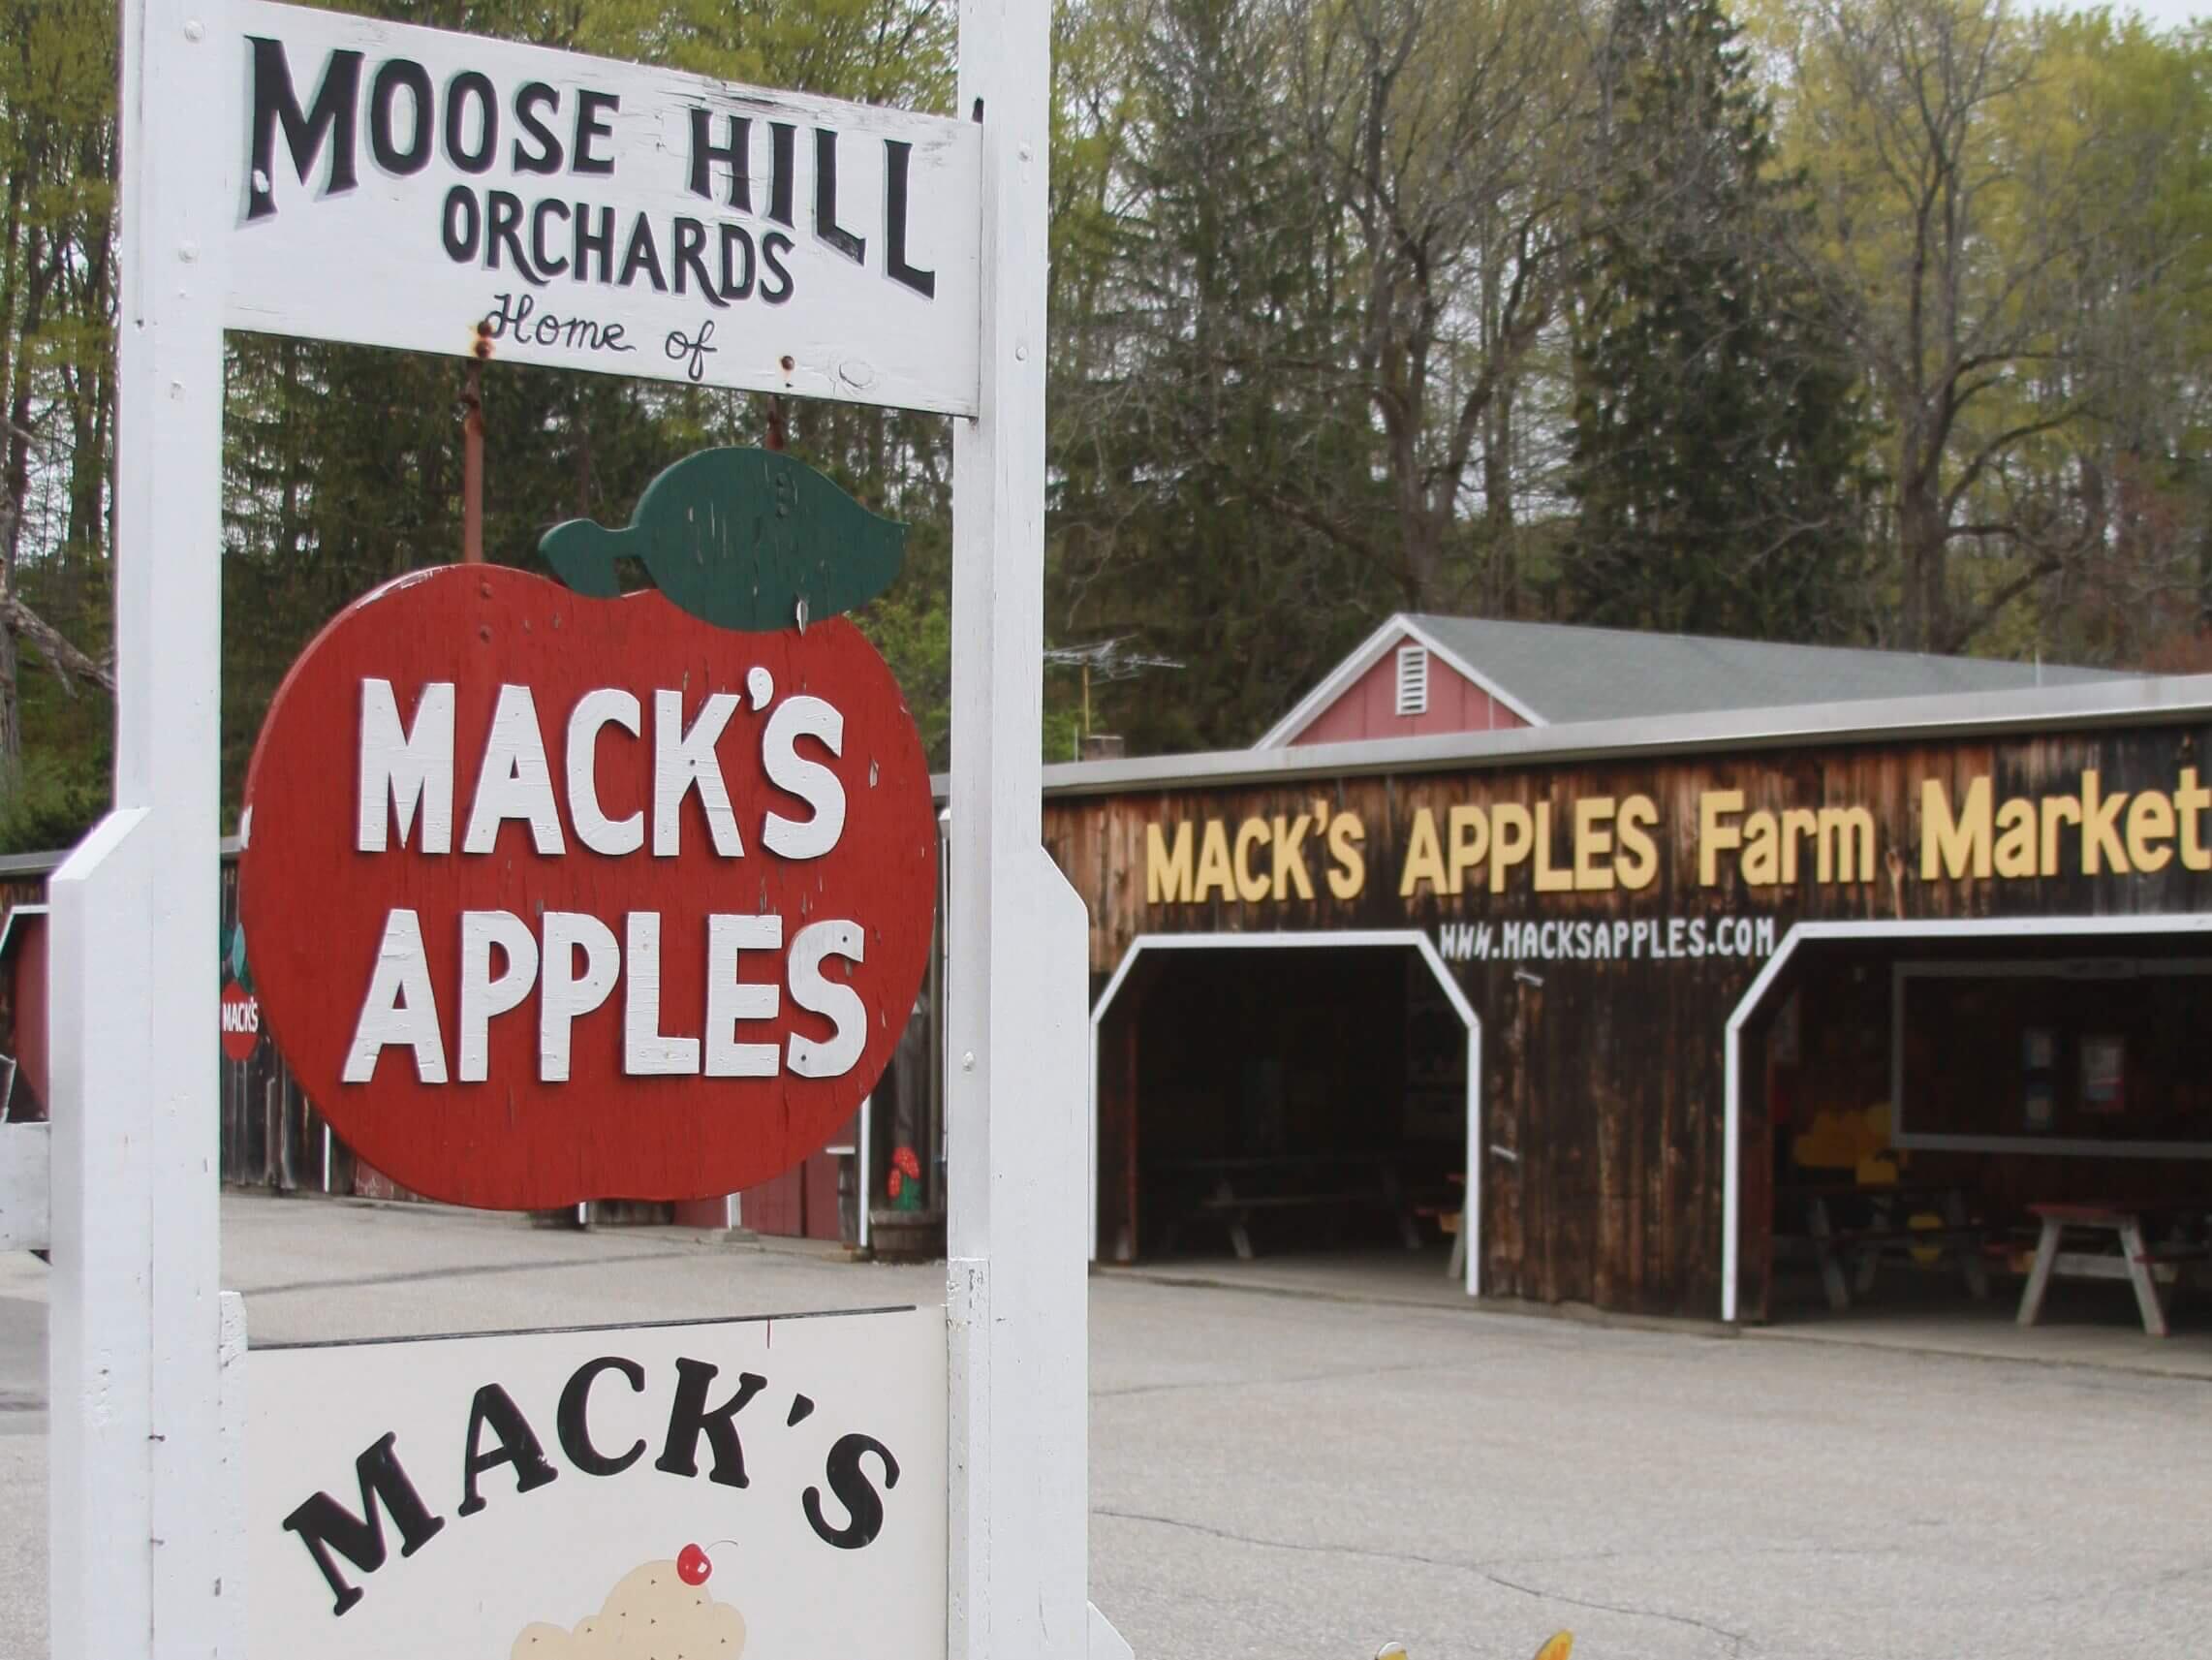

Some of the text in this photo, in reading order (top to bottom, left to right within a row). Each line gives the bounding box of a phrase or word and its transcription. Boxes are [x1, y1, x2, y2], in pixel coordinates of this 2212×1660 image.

[237, 35, 937, 301] MOOSE HILL
[442, 184, 796, 308] ORCHARDS
[486, 294, 718, 382] Home of
[358, 667, 846, 861] MACK'S
[1145, 767, 2212, 904] MACK'S APPLES Farm Market
[342, 909, 868, 1084] APPLES
[1438, 918, 1775, 962] WWW.MACKSAPPLES.COM
[222, 996, 259, 1033] MACK'S
[283, 1356, 900, 1616] MACK'S
